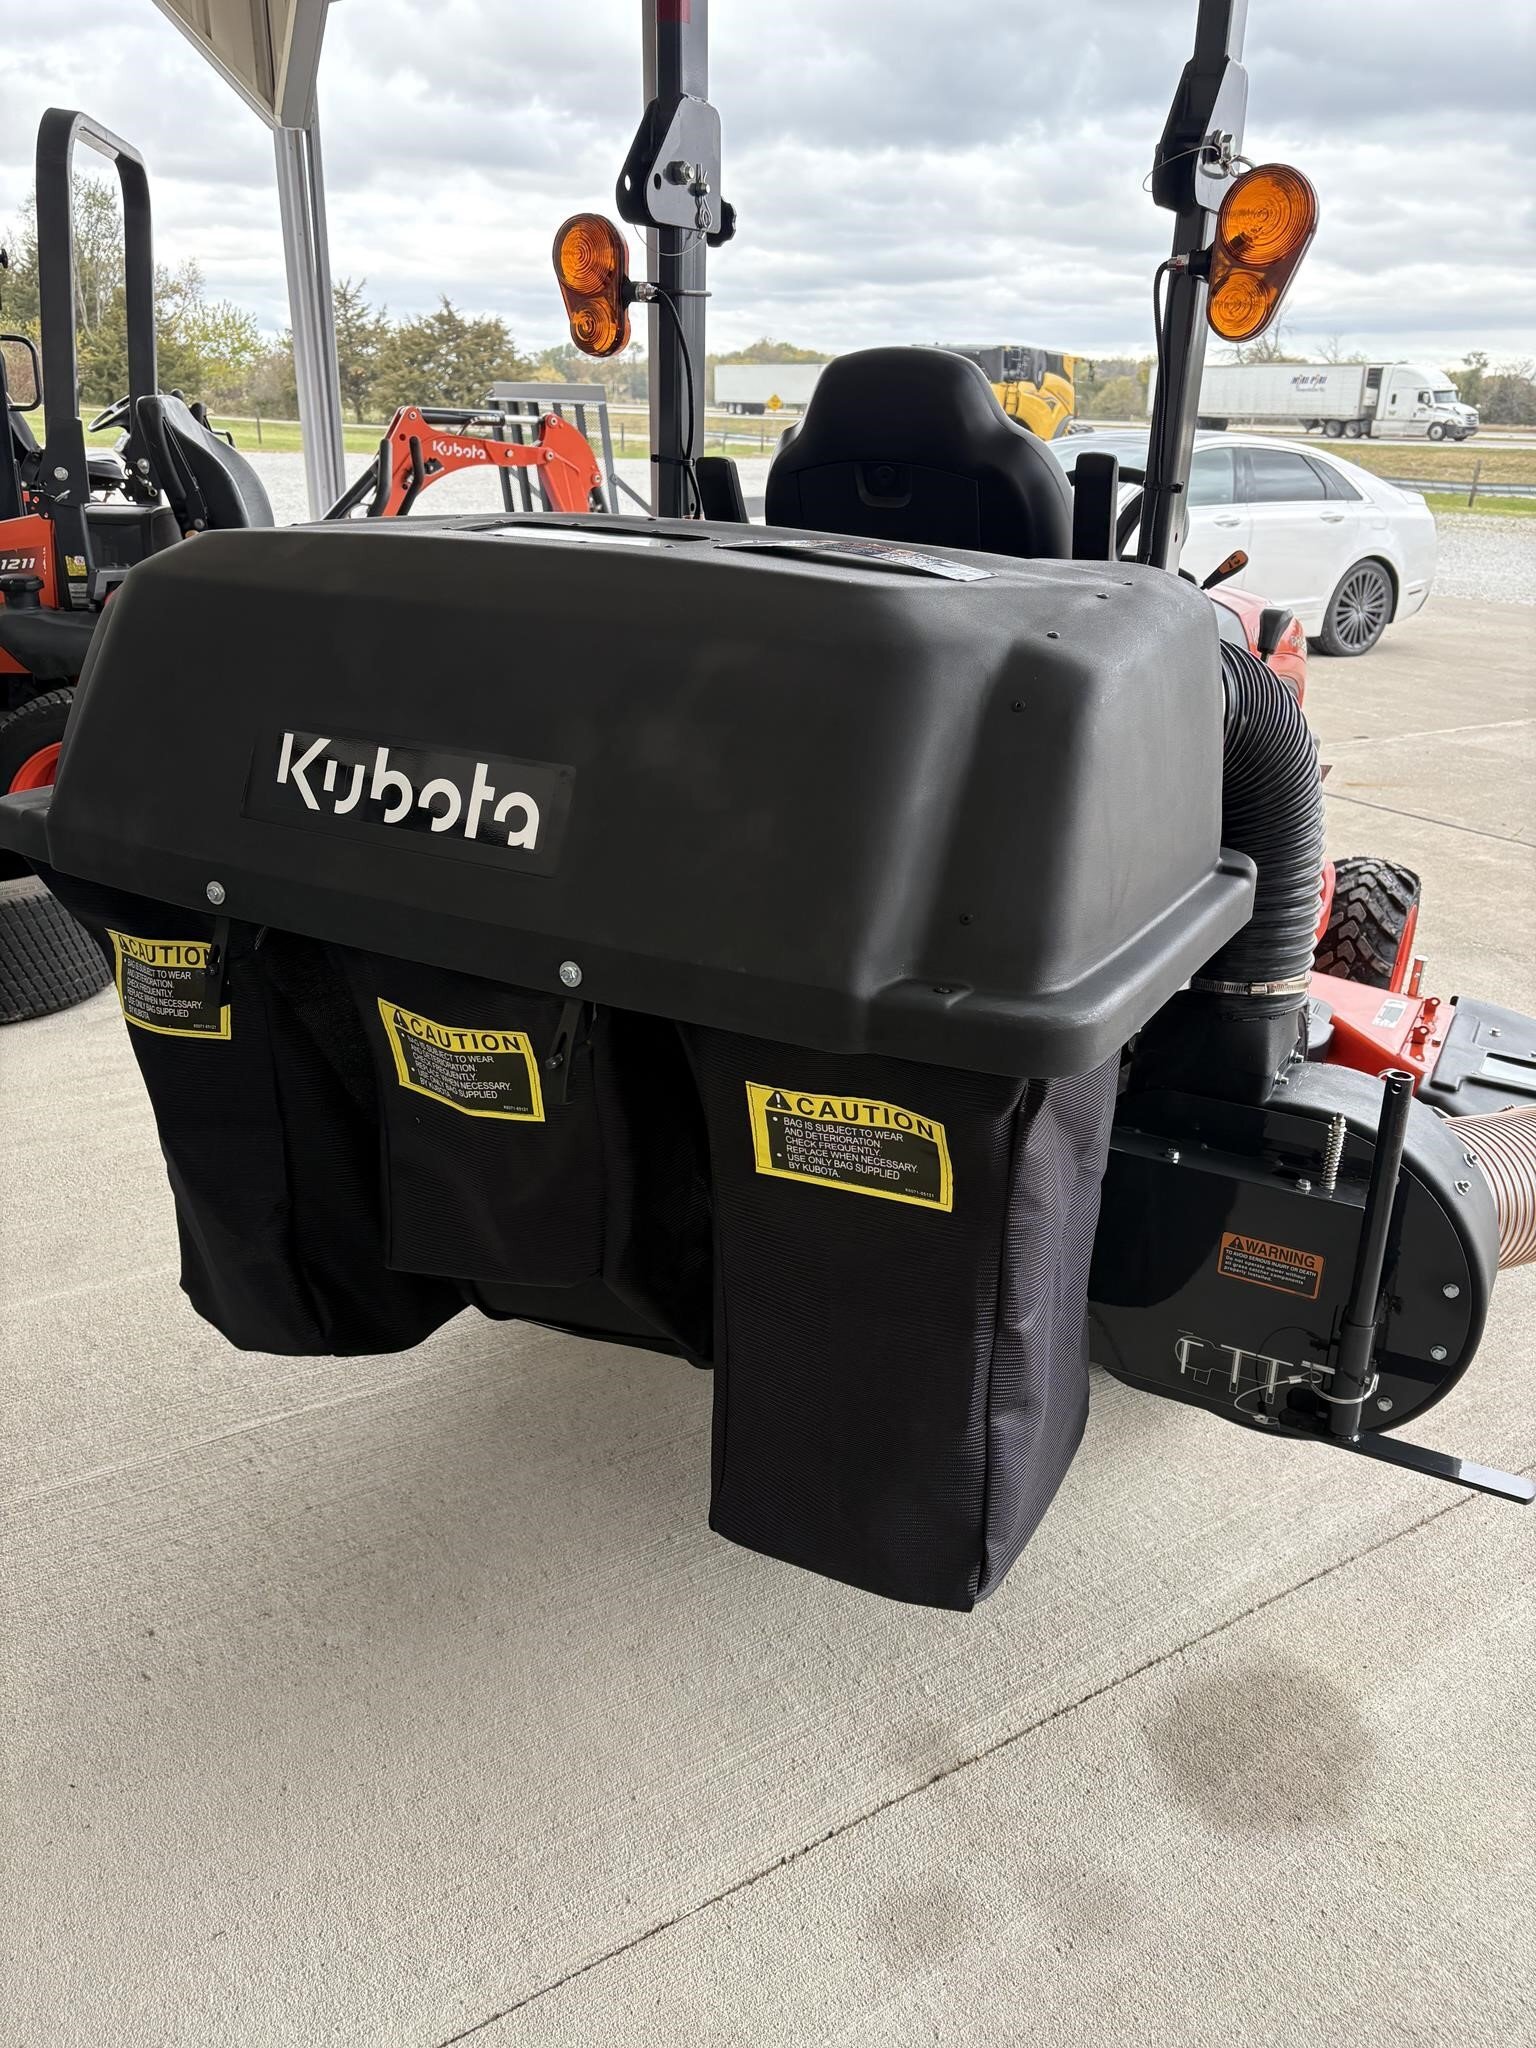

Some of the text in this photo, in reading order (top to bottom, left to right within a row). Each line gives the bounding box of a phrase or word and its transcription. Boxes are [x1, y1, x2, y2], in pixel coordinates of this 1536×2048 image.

[432, 439, 487, 460] Kubota
[0, 557, 36, 571] 1211
[276, 732, 540, 850] Kubota
[157, 970, 167, 979] TO
[168, 970, 192, 980] WEAR
[156, 1006, 190, 1018] SUPPLIED
[410, 1018, 521, 1051] CAUTION
[454, 1055, 467, 1063] TO
[467, 1055, 495, 1063] WEAR
[458, 1089, 498, 1099] SUPPLIED
[460, 1081, 512, 1091] NECESSARY.
[783, 1116, 904, 1142] BAG IS SUBJECT TO WEAR
[796, 1097, 935, 1140] CAUTION
[784, 1127, 882, 1149] AND DETERIORATION.
[785, 1136, 881, 1157] CHECK FREQUENTLY.
[786, 1145, 919, 1174] REPLACE WHEN NECESSARY.
[787, 1153, 900, 1181] USE ONLY BAG SUPPLIED
[788, 1162, 841, 1178] BY KUBOTA.
[1245, 1239, 1316, 1268] WARNING
[1299, 1268, 1317, 1277] DEATH
